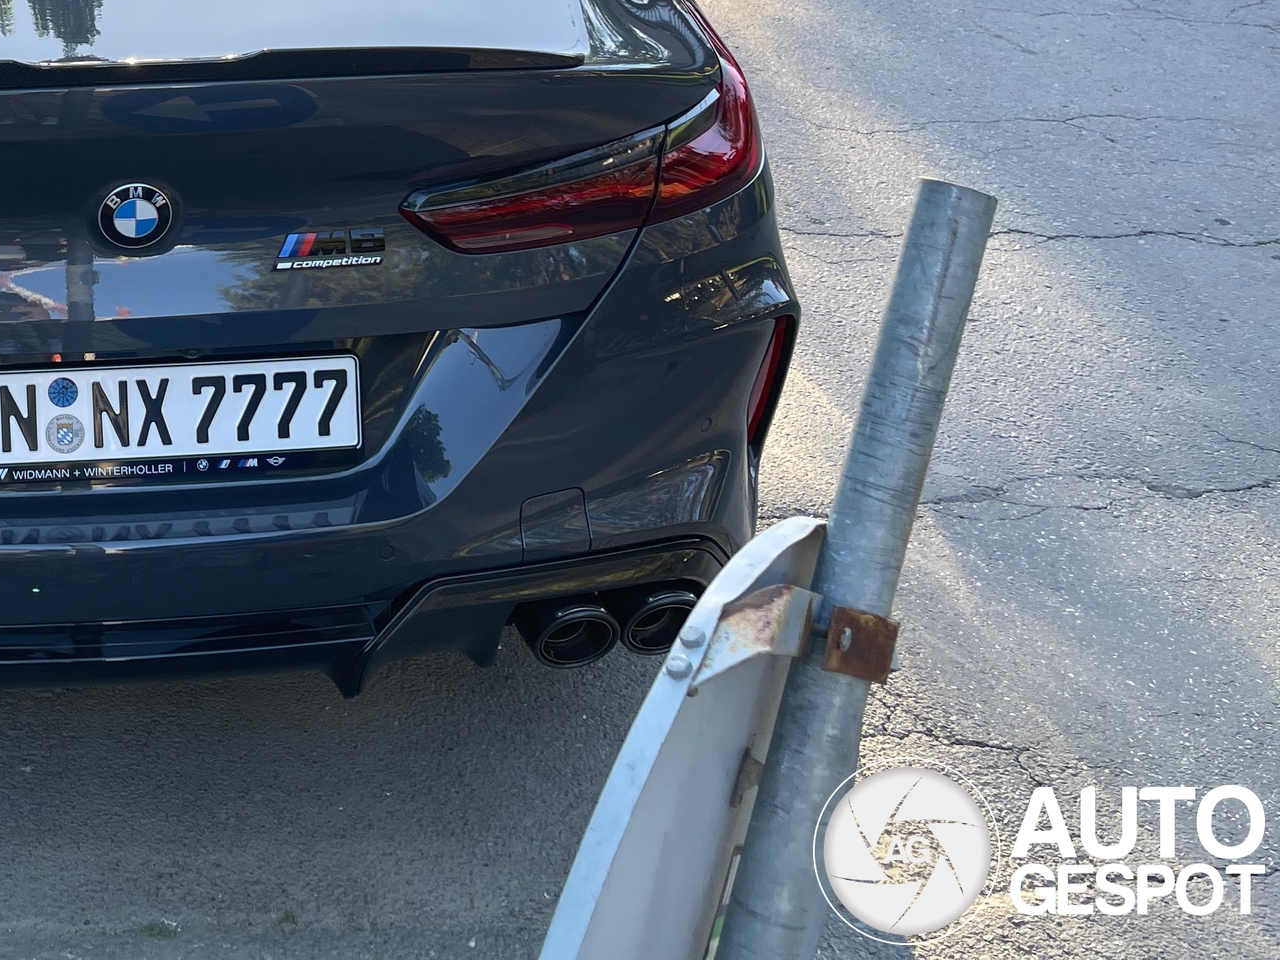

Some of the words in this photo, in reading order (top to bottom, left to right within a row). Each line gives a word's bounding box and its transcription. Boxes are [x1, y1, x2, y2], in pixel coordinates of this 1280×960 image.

[106, 186, 166, 210] BMW
[293, 255, 381, 269] competition
[92, 377, 173, 449] NX
[191, 369, 348, 444] 7777
[12, 468, 70, 481] WIDMANN
[73, 469, 81, 478] +
[83, 463, 173, 477] WINTERHOLLER
